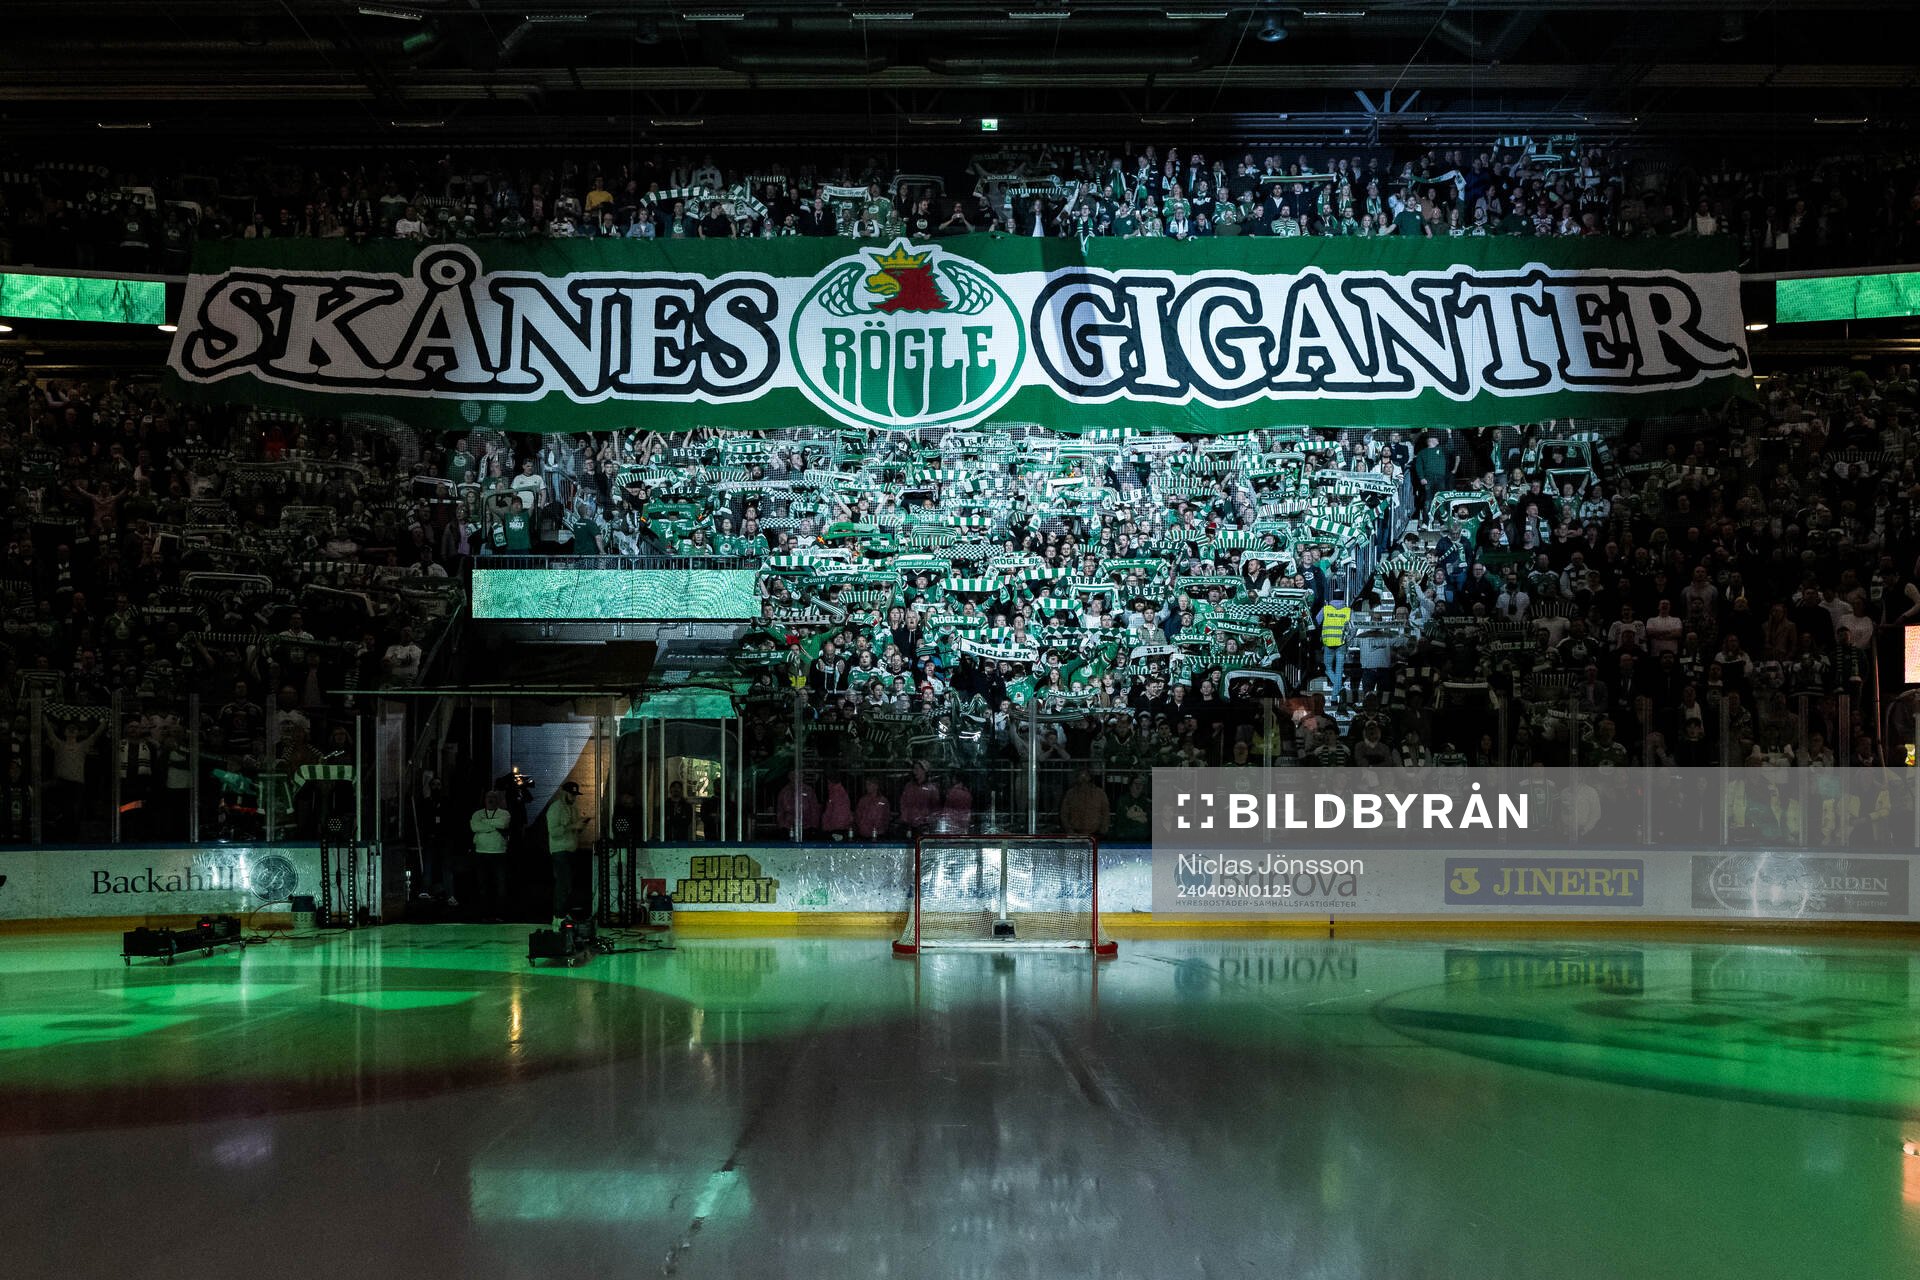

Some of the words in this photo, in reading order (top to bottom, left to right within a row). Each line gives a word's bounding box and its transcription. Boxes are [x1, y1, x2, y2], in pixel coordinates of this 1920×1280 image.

[182, 247, 781, 397] SKÅNES
[1030, 267, 1748, 397] GIGANTER
[822, 320, 997, 418] RÖGLE
[932, 615, 965, 625] RÖGLE
[967, 615, 981, 625] BK
[1204, 612, 1225, 620] CLUB
[1217, 622, 1245, 632] RÖGLE
[1175, 633, 1205, 641] RÖGLE
[969, 644, 1010, 658] RÖGLE
[1014, 651, 1032, 659] BK
[91, 866, 234, 895] Backahill
[690, 855, 751, 880] EURO
[1219, 860, 1358, 897] Brinova
[671, 878, 776, 904] JACKPOT
[1492, 867, 1640, 897] JINERT
